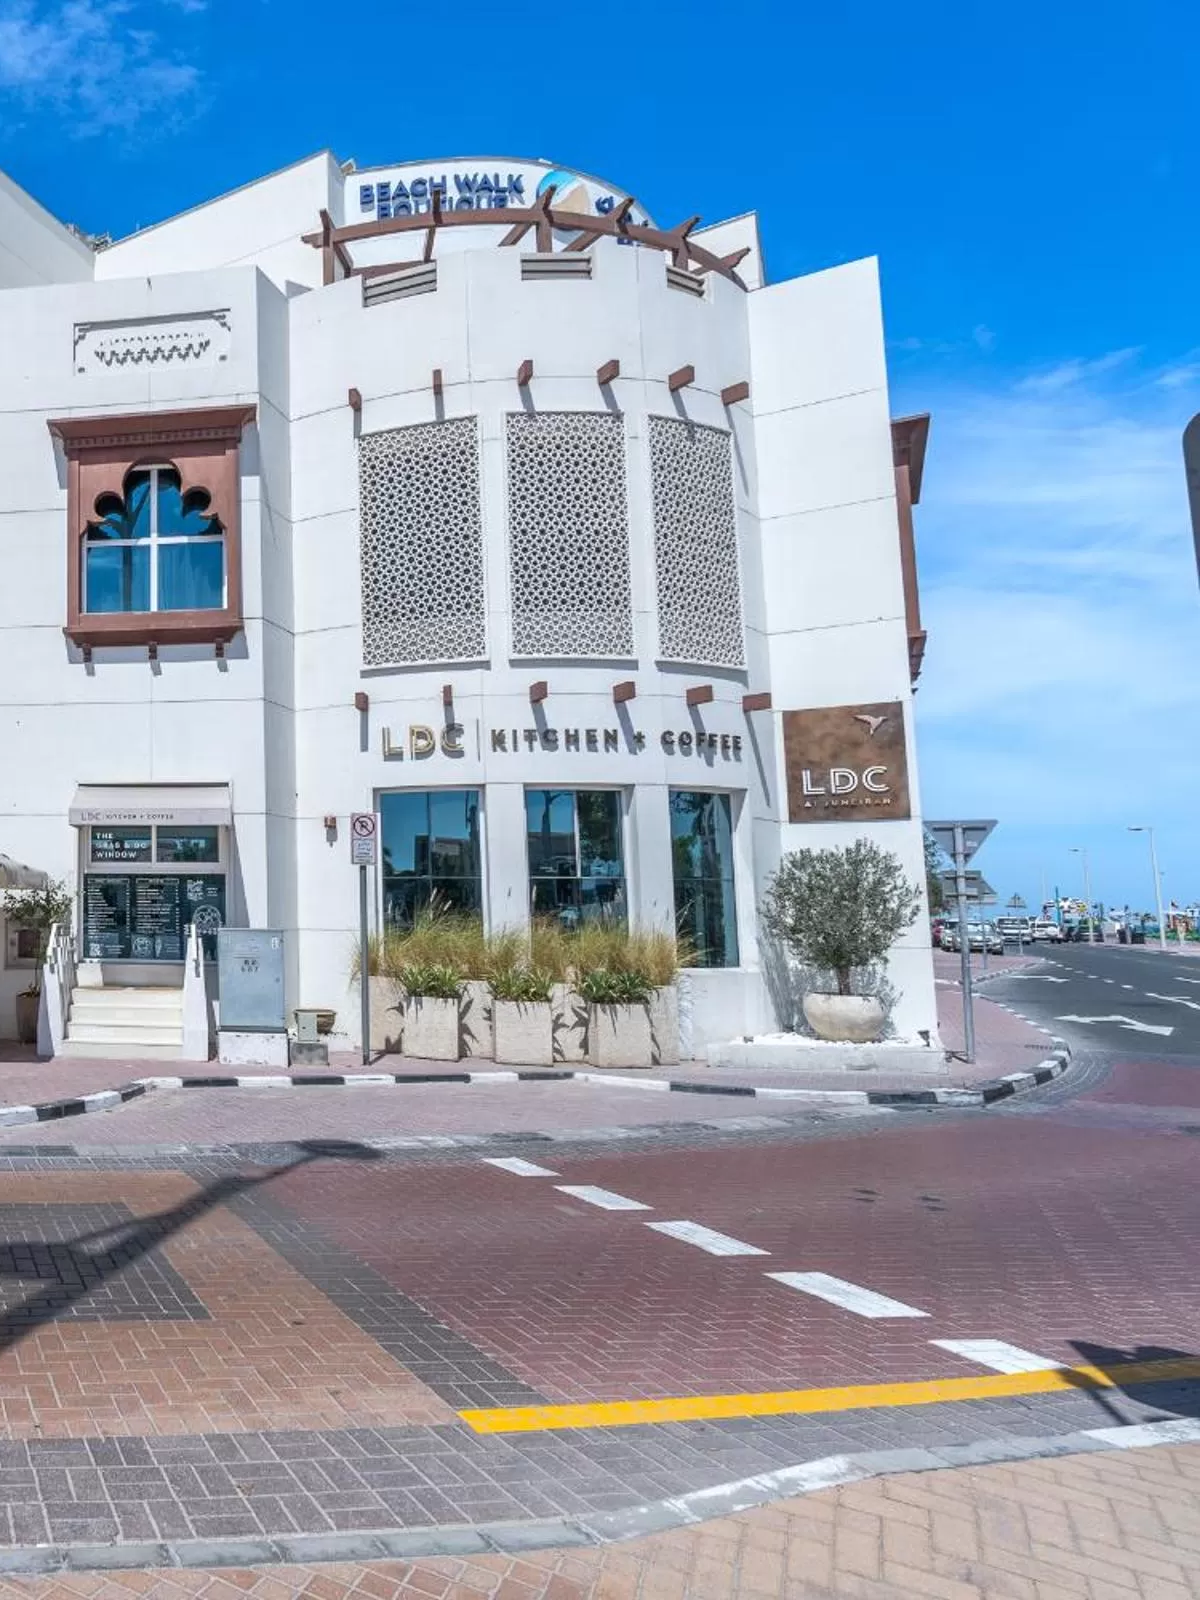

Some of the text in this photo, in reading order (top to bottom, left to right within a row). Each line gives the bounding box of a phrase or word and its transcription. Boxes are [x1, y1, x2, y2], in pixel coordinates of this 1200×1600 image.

[359, 171, 525, 207] BEACH WALK
[381, 722, 466, 759] LDC
[490, 728, 620, 750] KITCHEN
[660, 730, 743, 752] COFFEE
[802, 765, 891, 796] LDC
[95, 841, 120, 849] GRAB
[96, 832, 113, 840] THE
[95, 850, 138, 858] WINDOW
